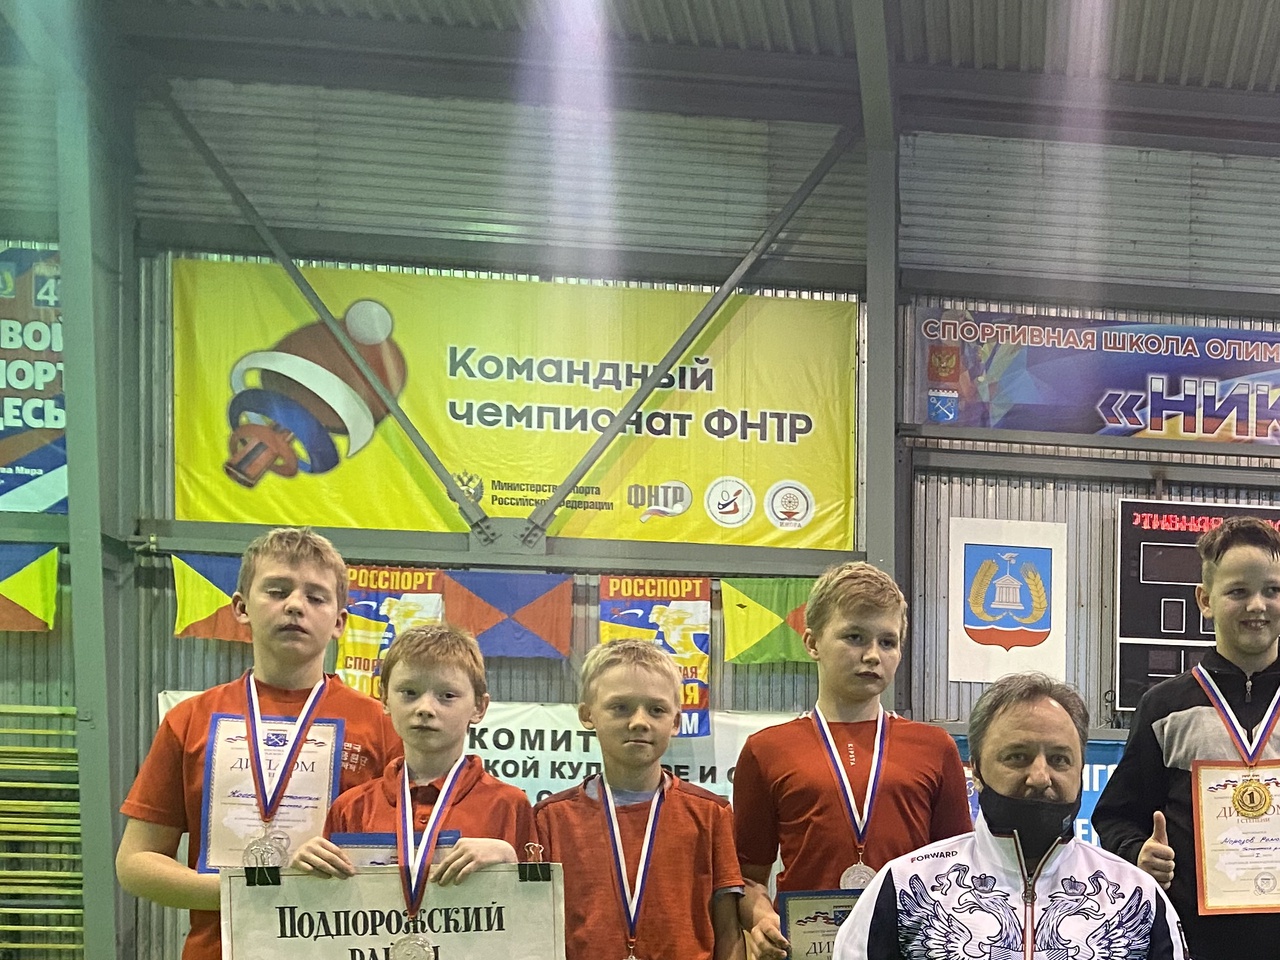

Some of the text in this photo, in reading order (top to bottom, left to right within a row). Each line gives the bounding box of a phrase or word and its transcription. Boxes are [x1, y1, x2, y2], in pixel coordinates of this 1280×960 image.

[922, 318, 1096, 352] СПОРТИВНАЯ
[1103, 332, 1198, 358] ШКОЛА
[703, 408, 814, 444] ФНТР
[491, 480, 601, 495] Министерств порта
[609, 578, 702, 598] РОССПОРТ
[910, 850, 959, 863] FORWARD
